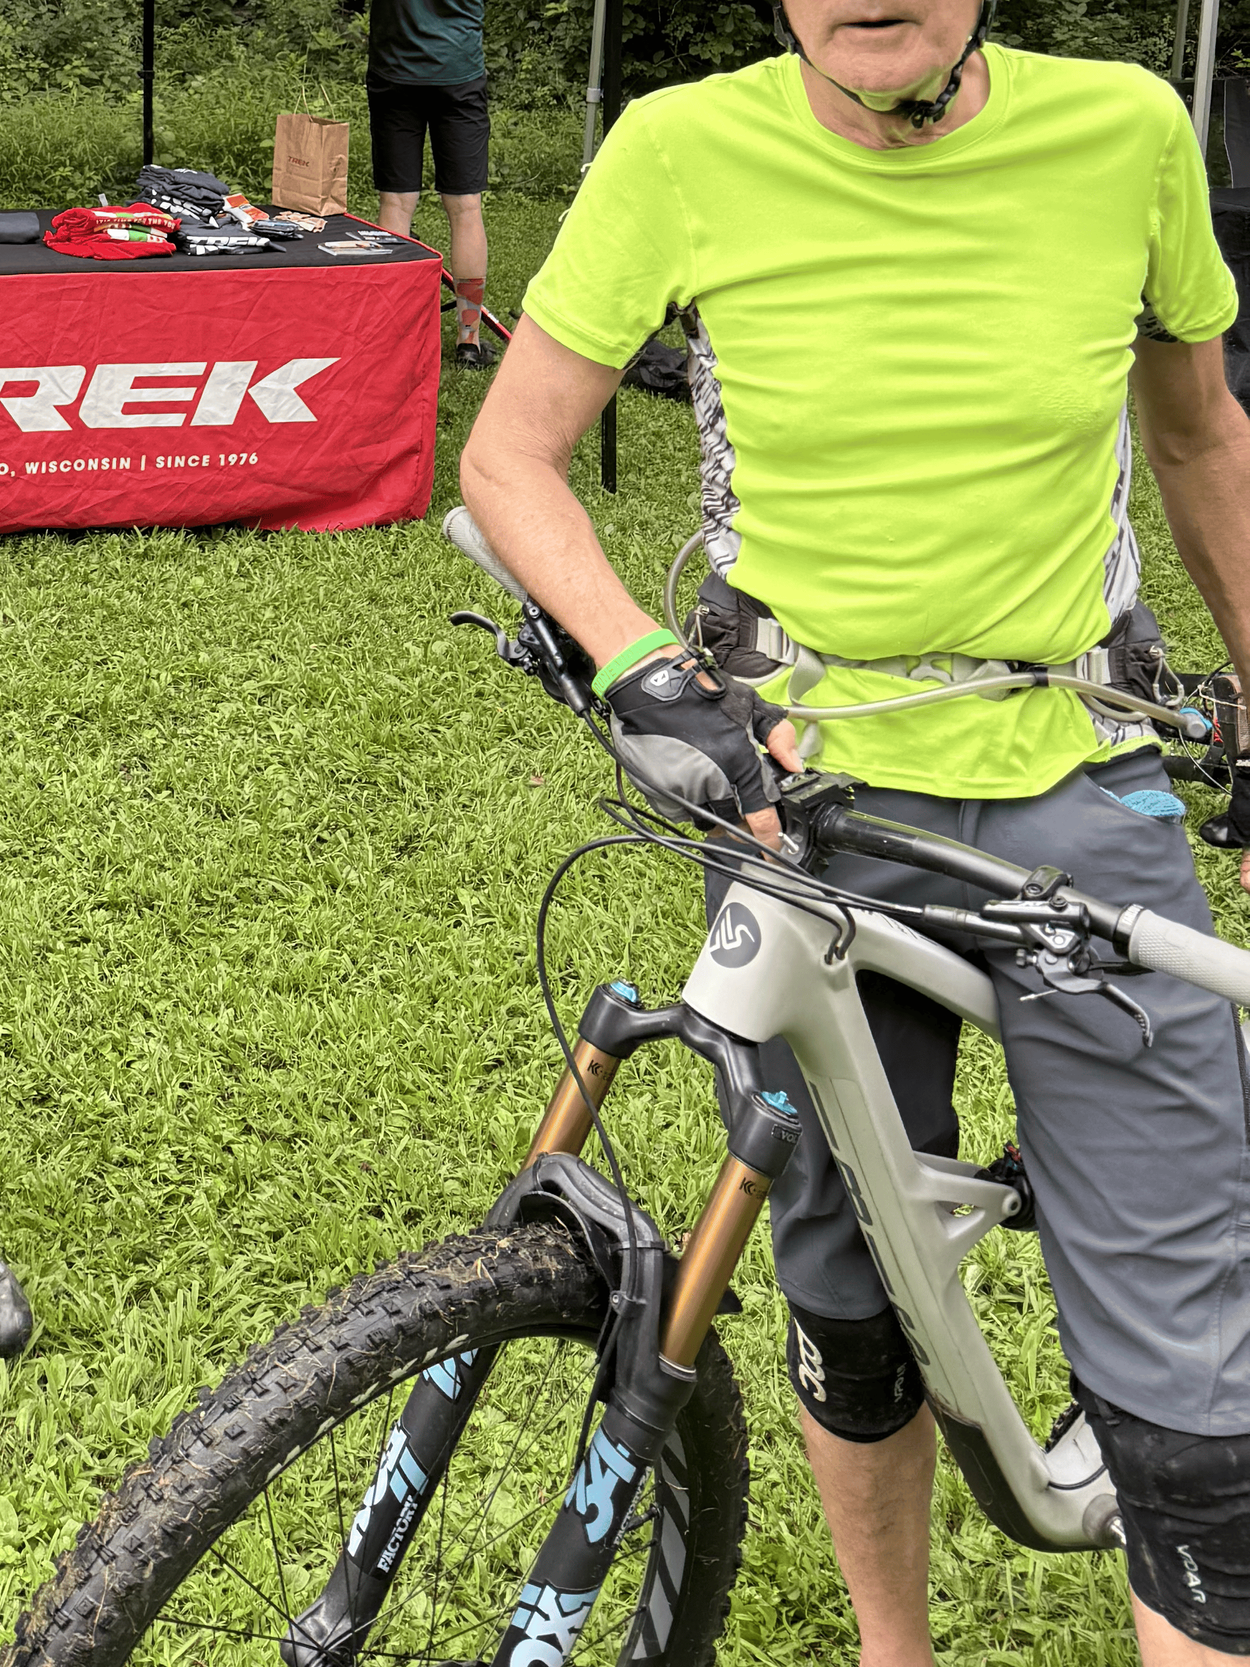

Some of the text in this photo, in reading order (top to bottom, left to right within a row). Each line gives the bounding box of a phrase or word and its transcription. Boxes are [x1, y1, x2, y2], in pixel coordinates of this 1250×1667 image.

[287, 155, 310, 168] TREK
[25, 456, 131, 474] WISCONSIN
[156, 455, 210, 468] SINCE
[218, 452, 259, 465] 1976
[376, 1494, 419, 1573] FACTORY
[510, 1584, 592, 1667] OX
